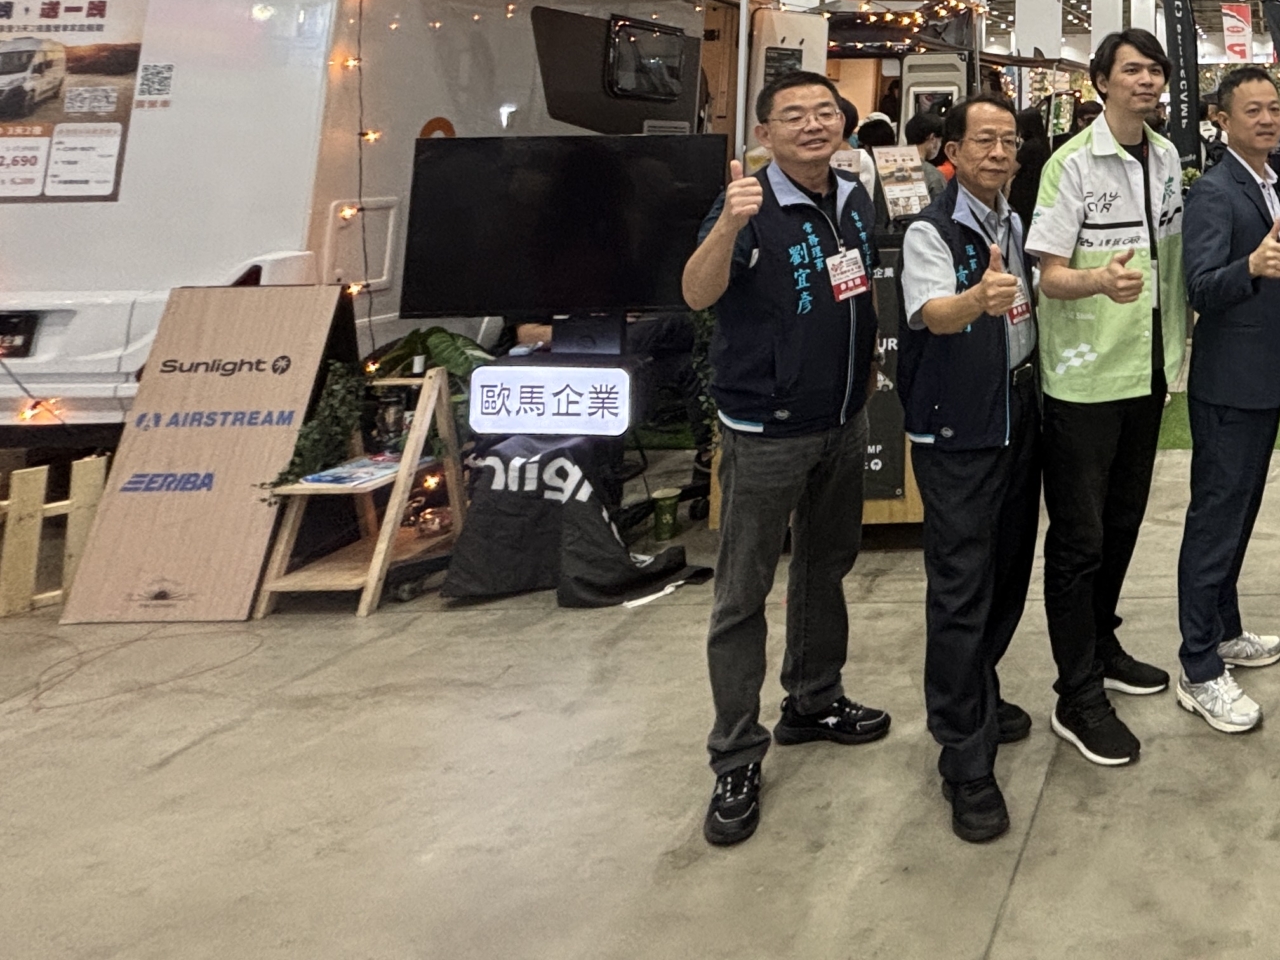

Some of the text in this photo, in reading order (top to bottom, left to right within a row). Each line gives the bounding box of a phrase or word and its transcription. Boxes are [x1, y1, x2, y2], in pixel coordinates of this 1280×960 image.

[160, 359, 268, 377] Sunlight
[480, 382, 619, 418] 歐馬企業
[165, 410, 295, 428] AIRSTREAM
[132, 472, 215, 492] ERIBA
